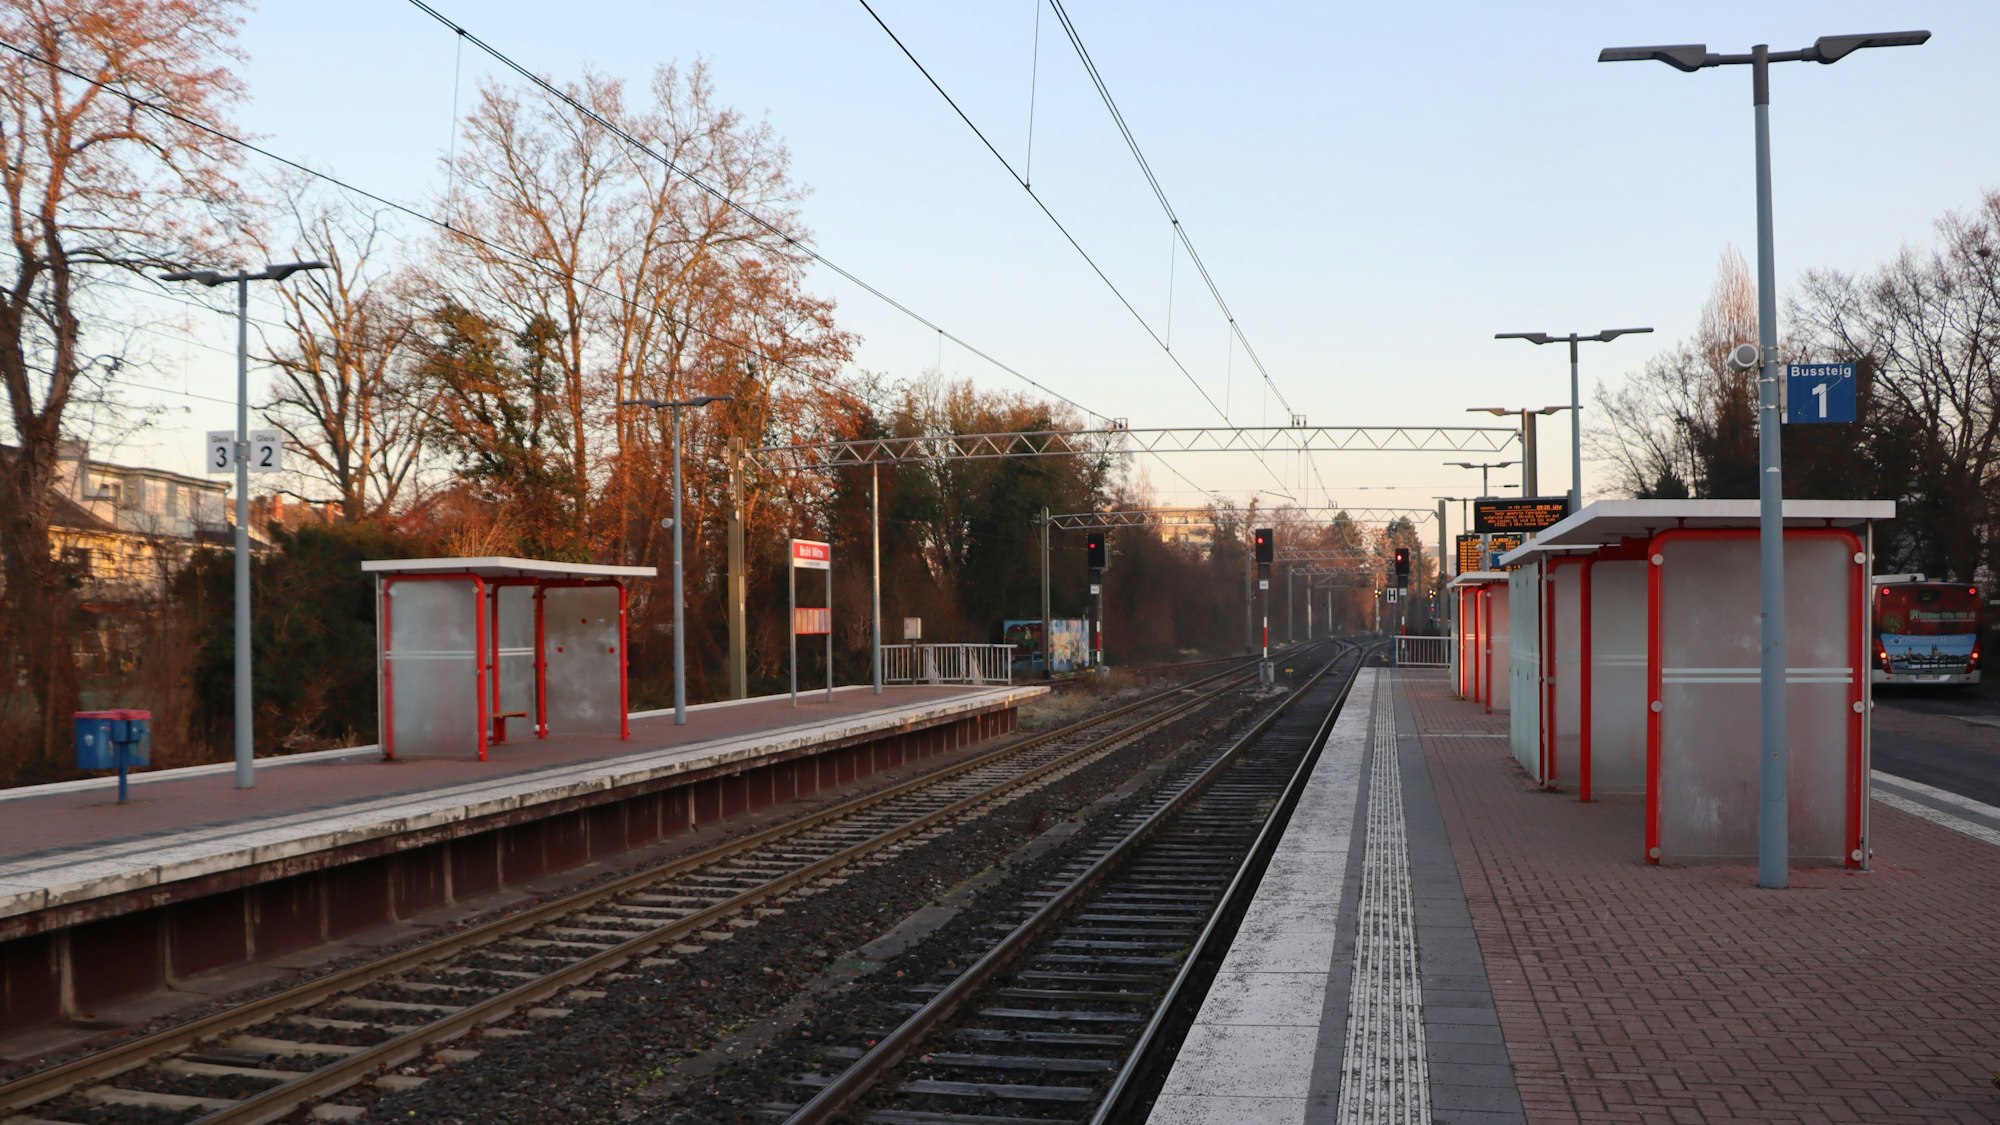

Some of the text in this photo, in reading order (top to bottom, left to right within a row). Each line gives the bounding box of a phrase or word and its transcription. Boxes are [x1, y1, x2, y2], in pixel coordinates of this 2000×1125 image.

[1791, 365, 1852, 378] Bussteig
[1811, 383, 1827, 418] 1
[255, 434, 275, 442] Gleis
[215, 446, 227, 468] 3
[259, 446, 273, 467] 2
[1389, 590, 1396, 601] H
